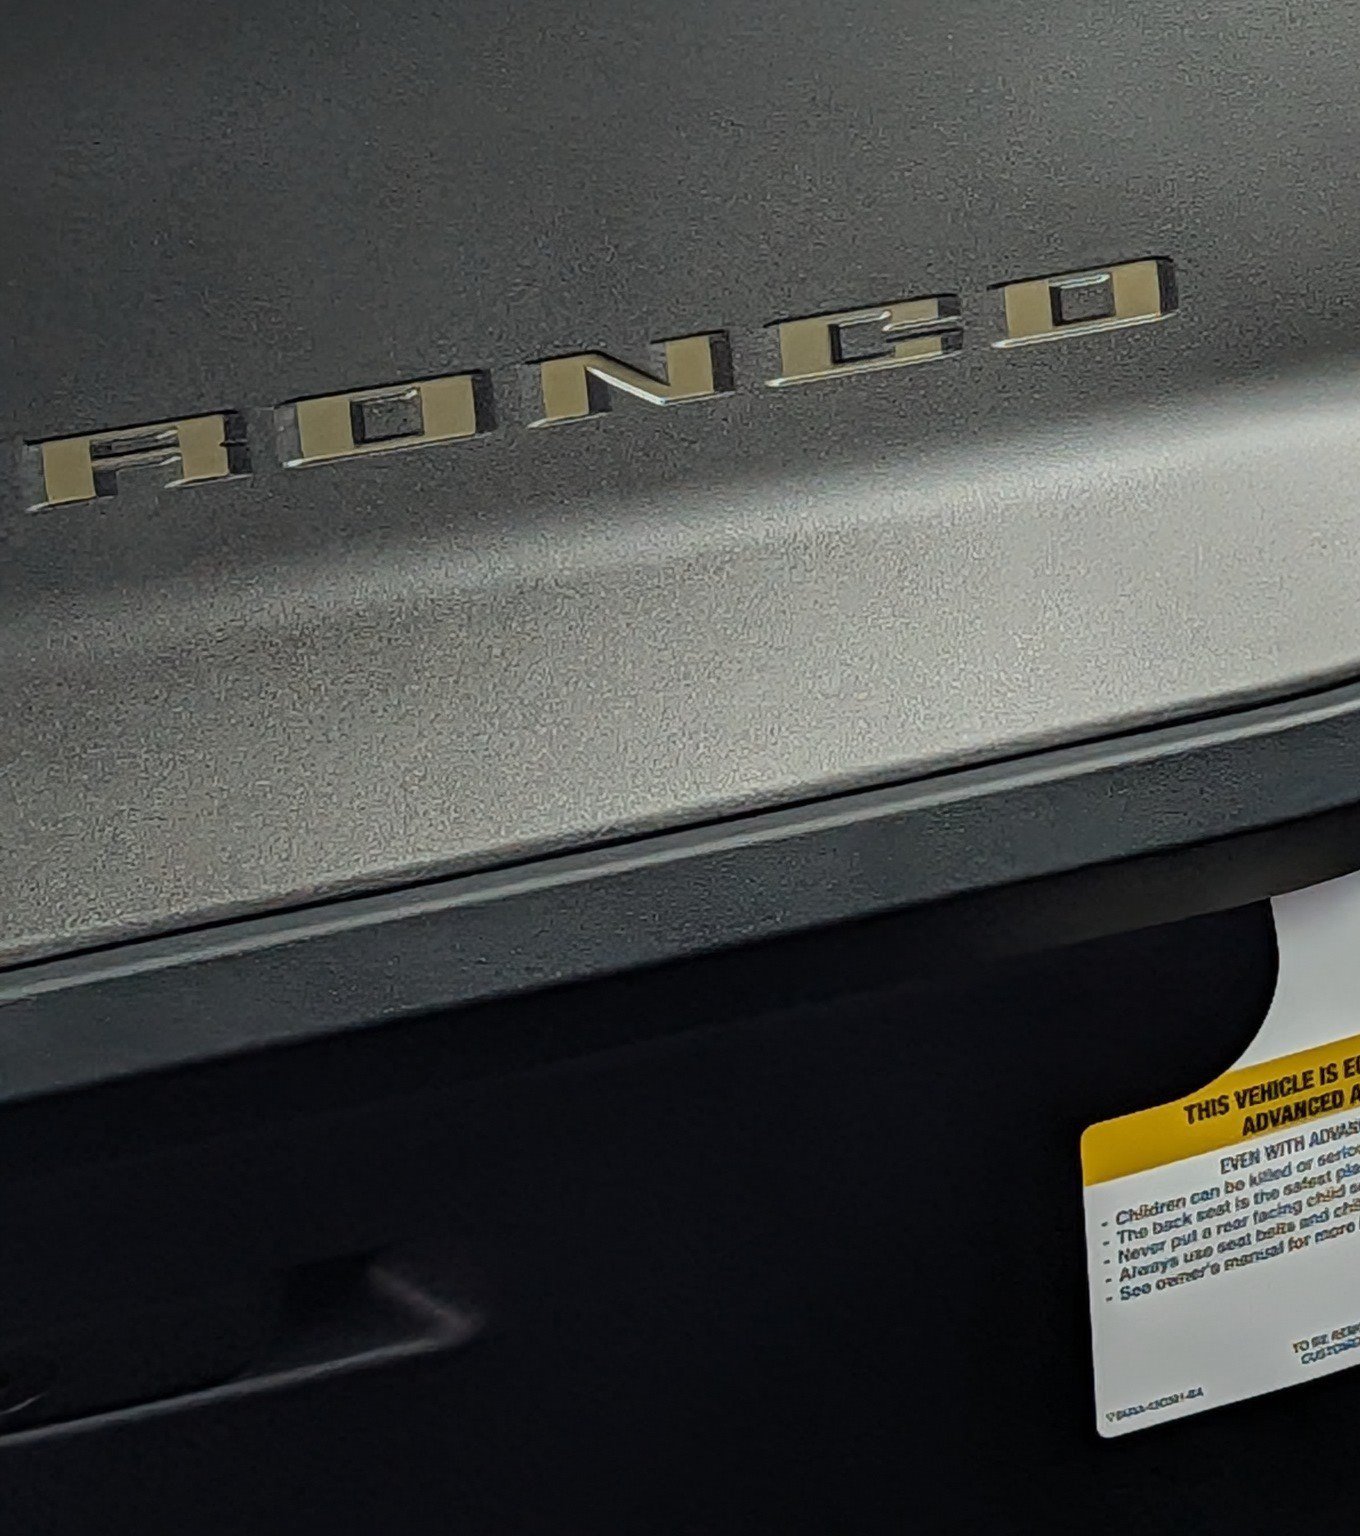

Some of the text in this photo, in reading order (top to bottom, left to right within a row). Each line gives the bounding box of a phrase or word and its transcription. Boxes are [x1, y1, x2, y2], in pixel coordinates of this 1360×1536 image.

[1183, 1094, 1229, 1125] THIS
[1233, 1069, 1314, 1110] VEHICLE
[1320, 1062, 1338, 1084] IS
[1242, 1089, 1344, 1135] ADVANCED
[1220, 1149, 1260, 1173] EVEN
[1264, 1136, 1305, 1160] WITH
[1115, 1194, 1185, 1225] Children
[1190, 1184, 1220, 1204] can
[1224, 1176, 1245, 1193] be
[1296, 1160, 1311, 1172] or
[1116, 1223, 1148, 1243] The
[1153, 1211, 1192, 1234] back
[1235, 1195, 1249, 1209] is
[1253, 1186, 1279, 1204] the
[1118, 1238, 1166, 1263] Never
[1202, 1228, 1211, 1238] a
